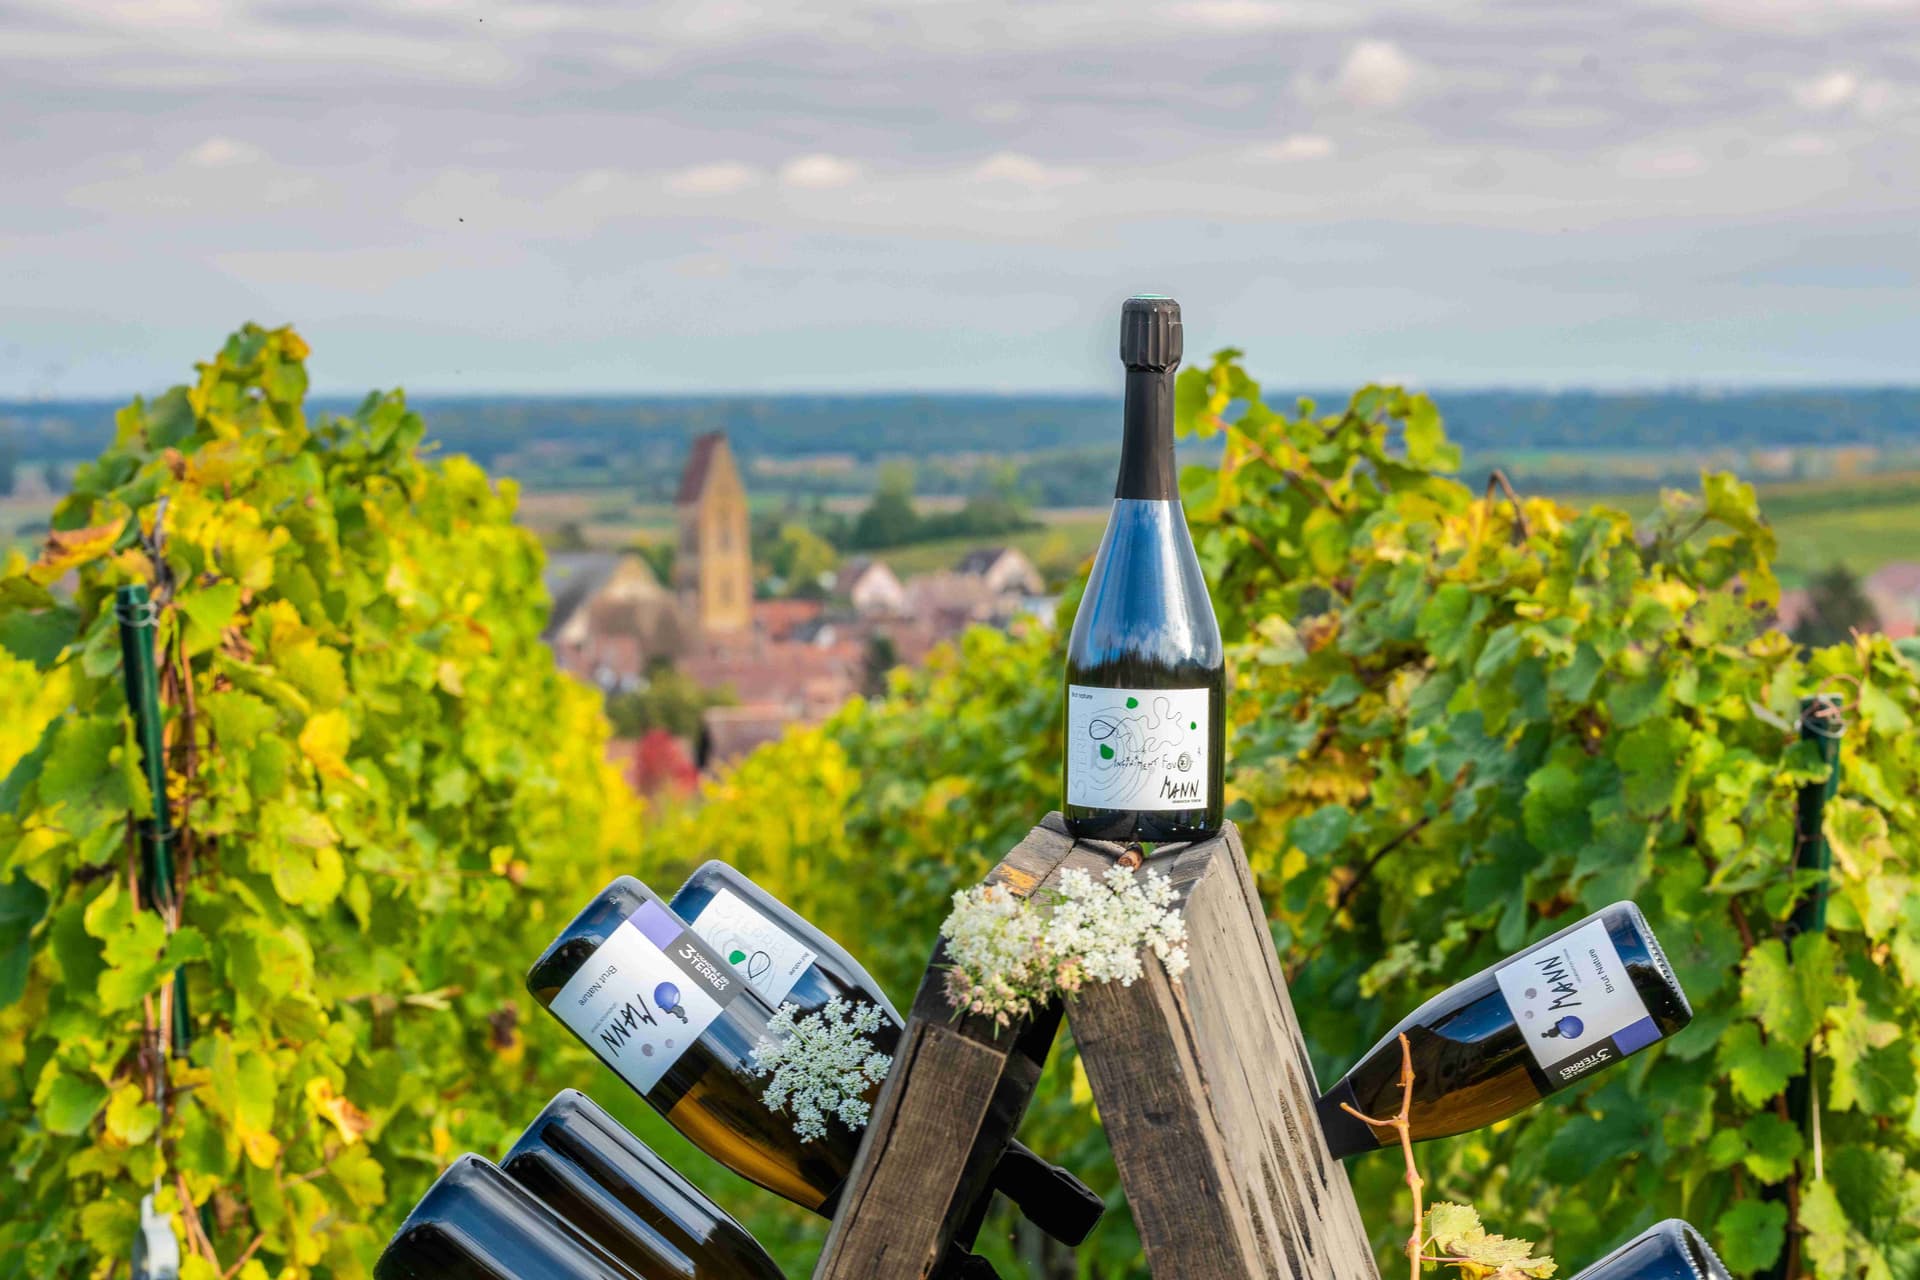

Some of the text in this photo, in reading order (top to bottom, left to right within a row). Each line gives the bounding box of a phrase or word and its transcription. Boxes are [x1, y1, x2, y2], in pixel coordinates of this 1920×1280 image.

[1160, 775, 1199, 799] MANN
[600, 964, 617, 985] Brut
[679, 942, 726, 992] 3 TERRES
[1535, 956, 1582, 1010] MANN
[1588, 948, 1615, 994] Brut Nature
[578, 982, 602, 1007] Nature
[600, 994, 657, 1058] MANN
[1559, 1048, 1612, 1077] 3 TERRES
